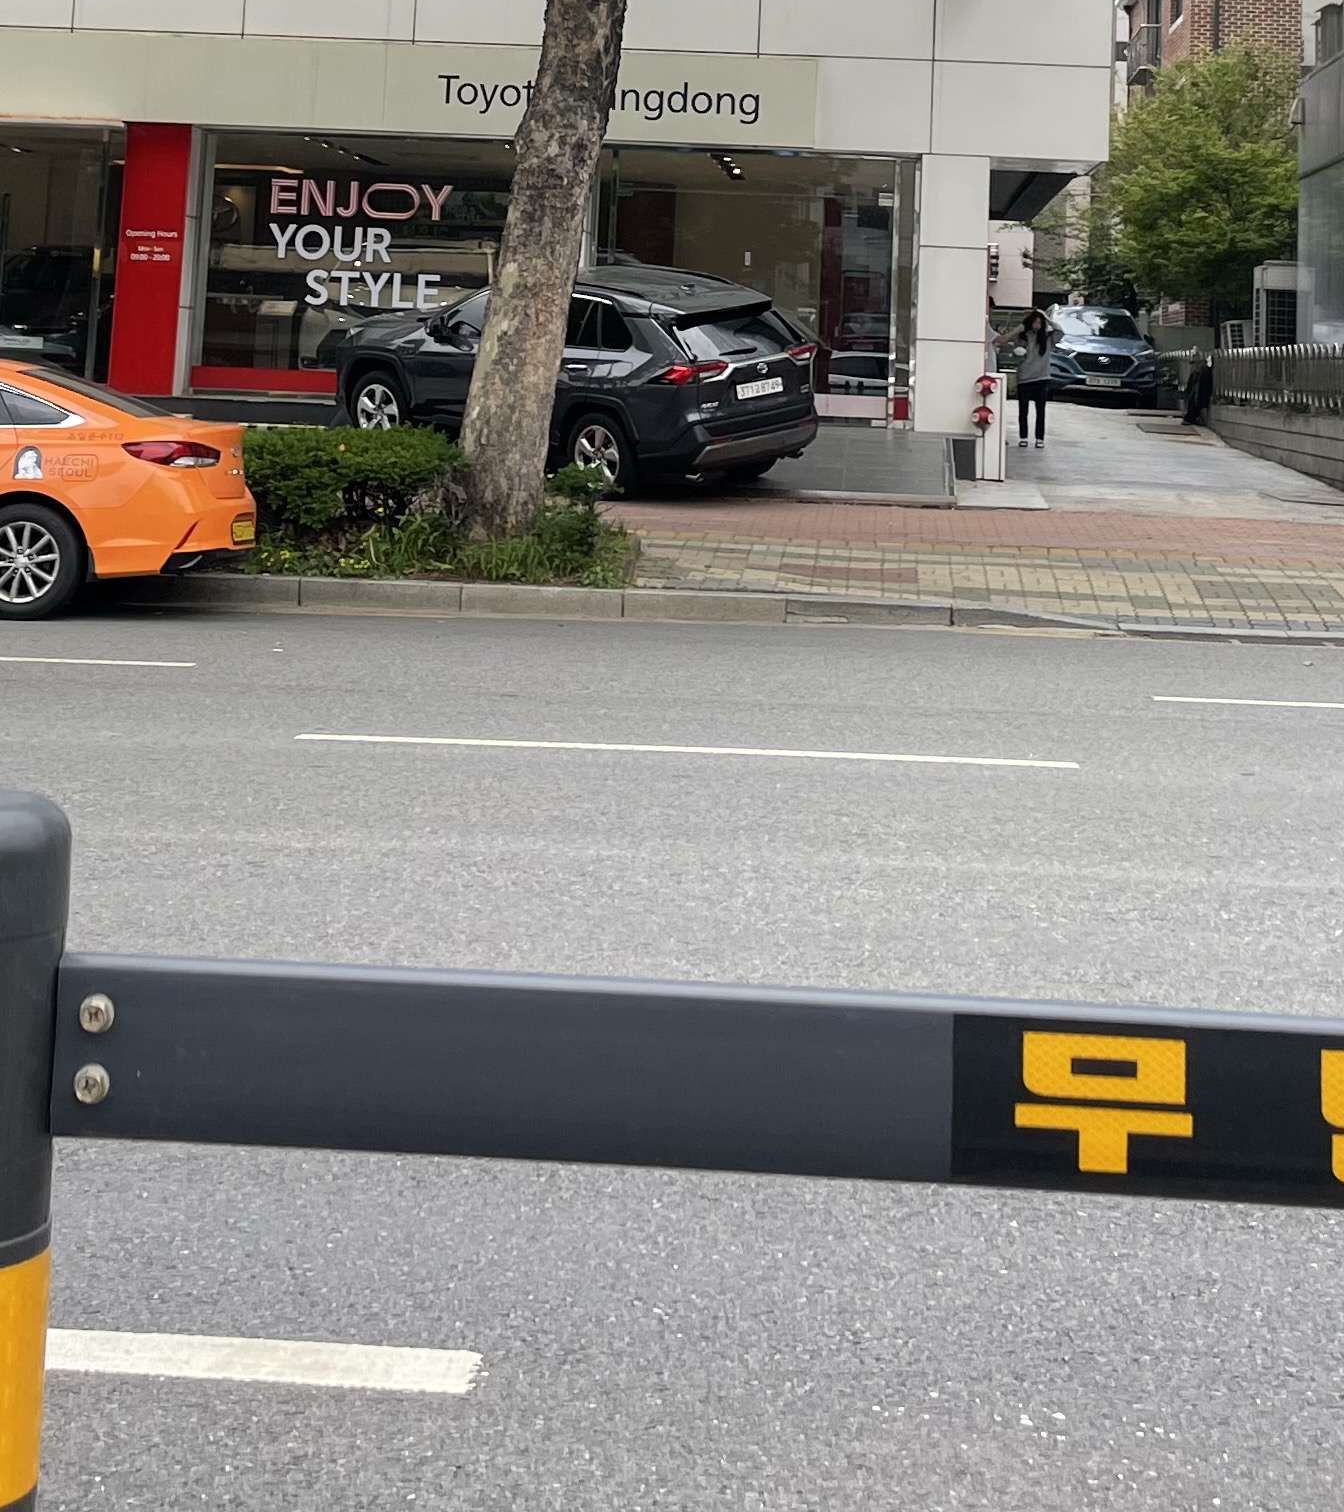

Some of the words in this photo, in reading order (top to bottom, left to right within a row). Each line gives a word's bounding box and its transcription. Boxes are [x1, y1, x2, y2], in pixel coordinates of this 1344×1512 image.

[437, 74, 537, 115] Toyot
[269, 177, 454, 221] ENJOY
[268, 222, 392, 264] YOUR
[304, 268, 441, 309] STYLE
